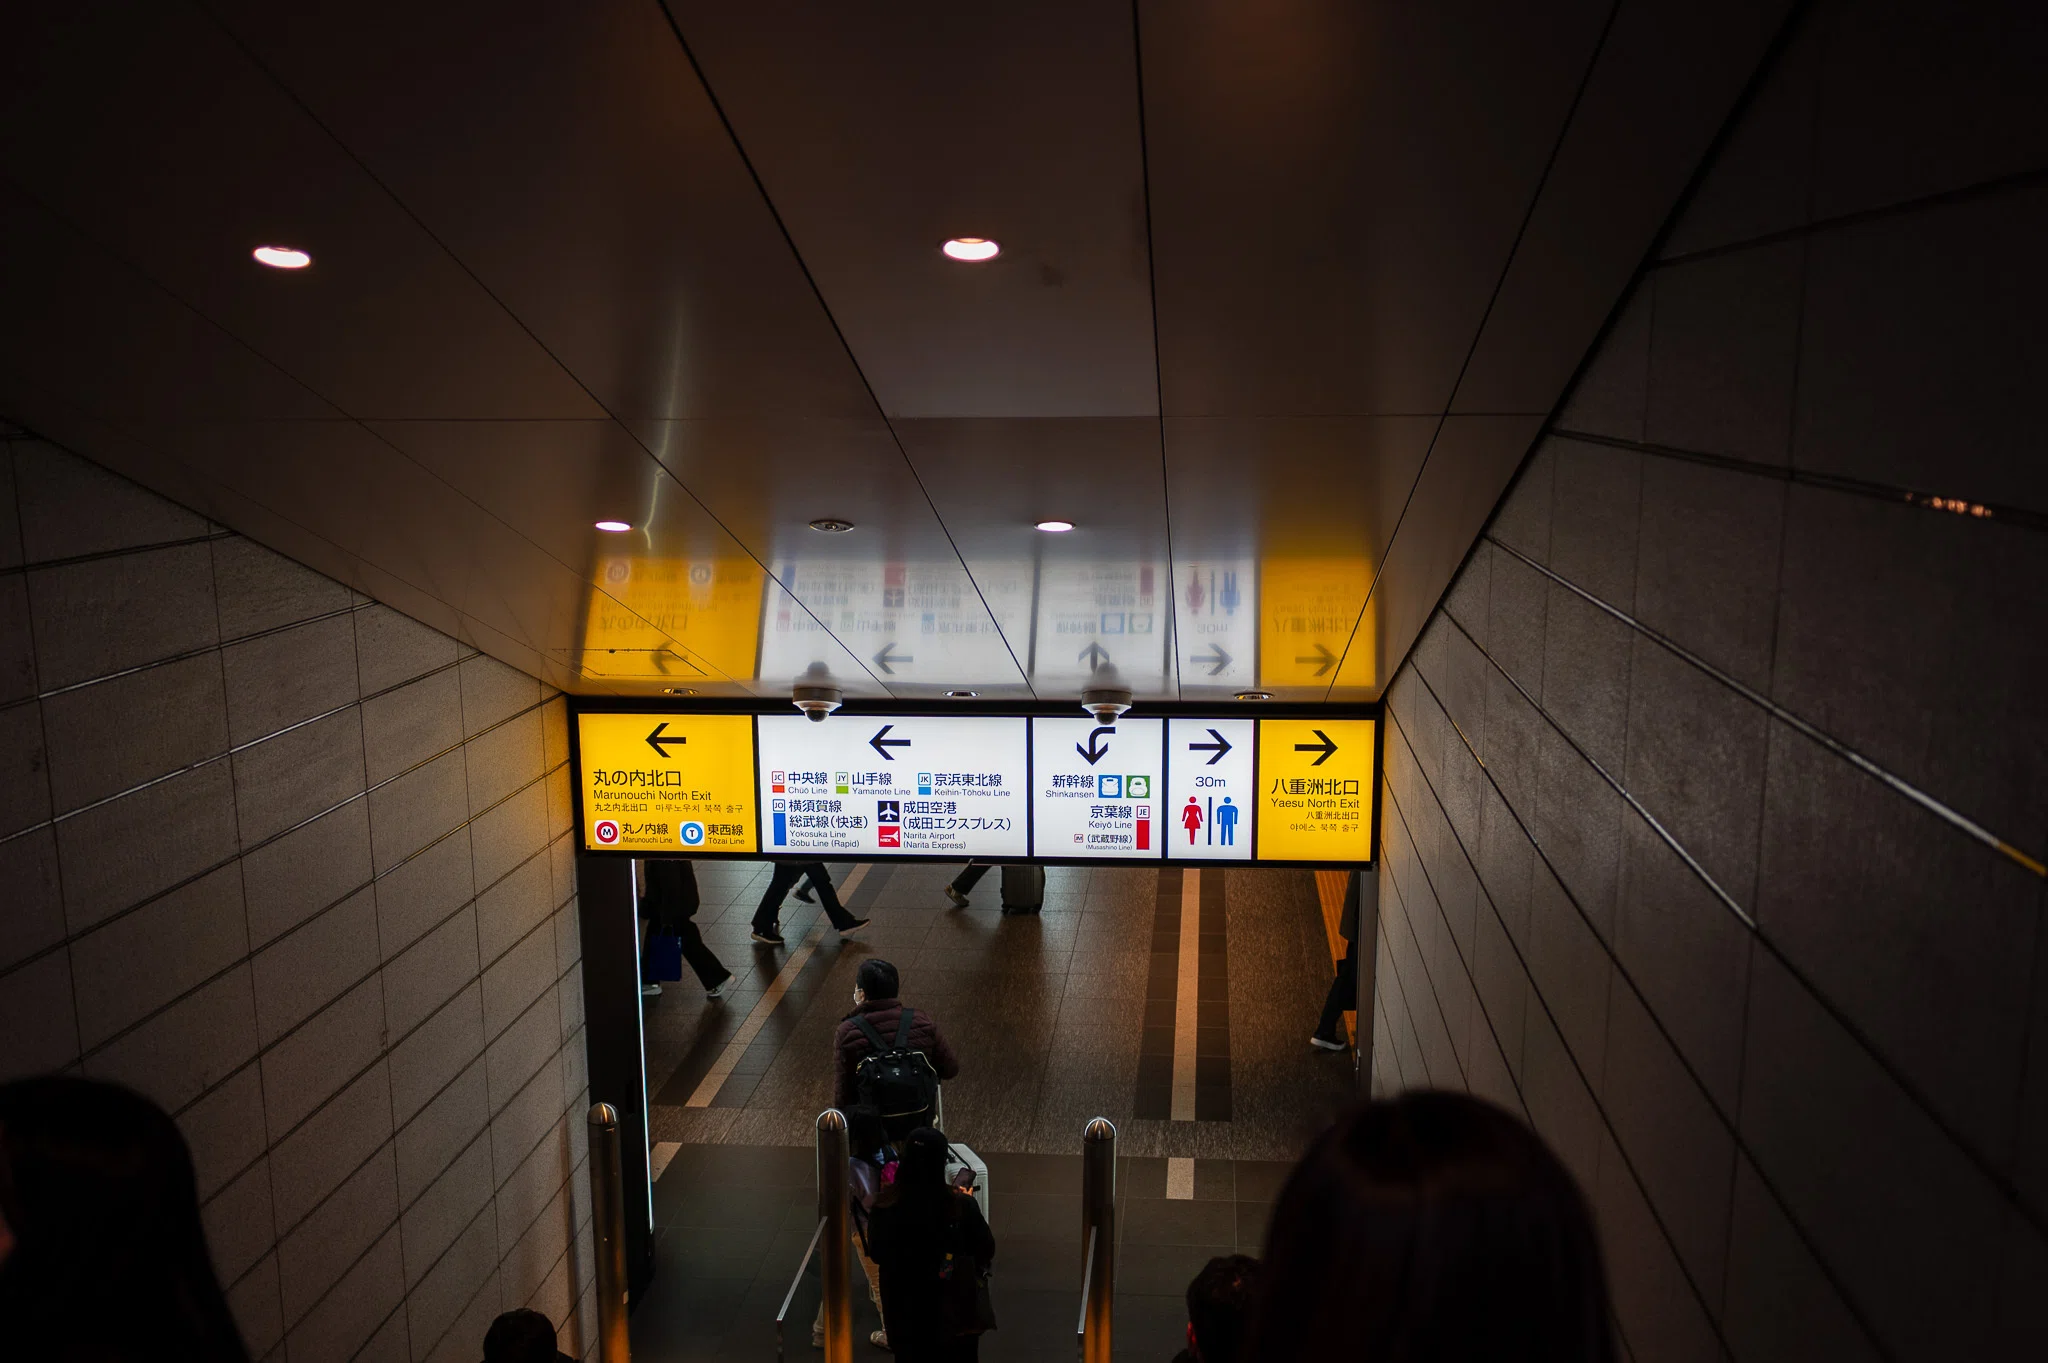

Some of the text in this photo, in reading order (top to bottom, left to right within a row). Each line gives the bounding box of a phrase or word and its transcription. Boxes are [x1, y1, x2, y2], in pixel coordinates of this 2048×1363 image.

[593, 769, 682, 787] 丸の内北口
[788, 771, 828, 784] 中央線
[852, 772, 892, 785] 山手線
[934, 773, 1002, 787] 京浜東北線
[1052, 774, 1094, 788] 新幹線
[1195, 776, 1226, 788] 30m
[1271, 778, 1359, 795] 八重洲北口
[593, 790, 712, 801] Marunouchi North Exit
[1046, 790, 1095, 798] Shinkansen
[594, 803, 648, 812] 丸之内北出口
[789, 800, 842, 813] 横須賀線
[903, 801, 957, 814] 成田空港
[1271, 798, 1360, 808] Yaesu North Exit
[1090, 805, 1132, 818] 京葉線
[1306, 811, 1359, 820] 八重洲北出口
[790, 815, 868, 828] 総武線(快速)
[903, 817, 1011, 831] (成田エクスプレス)
[622, 823, 669, 835] 丸ノ内線
[707, 824, 744, 836] 東西線
[790, 830, 828, 838] Yokosuka
[929, 832, 955, 841] Airport
[831, 840, 859, 848] (Rapid)
[904, 841, 966, 850] (Narita Express)
